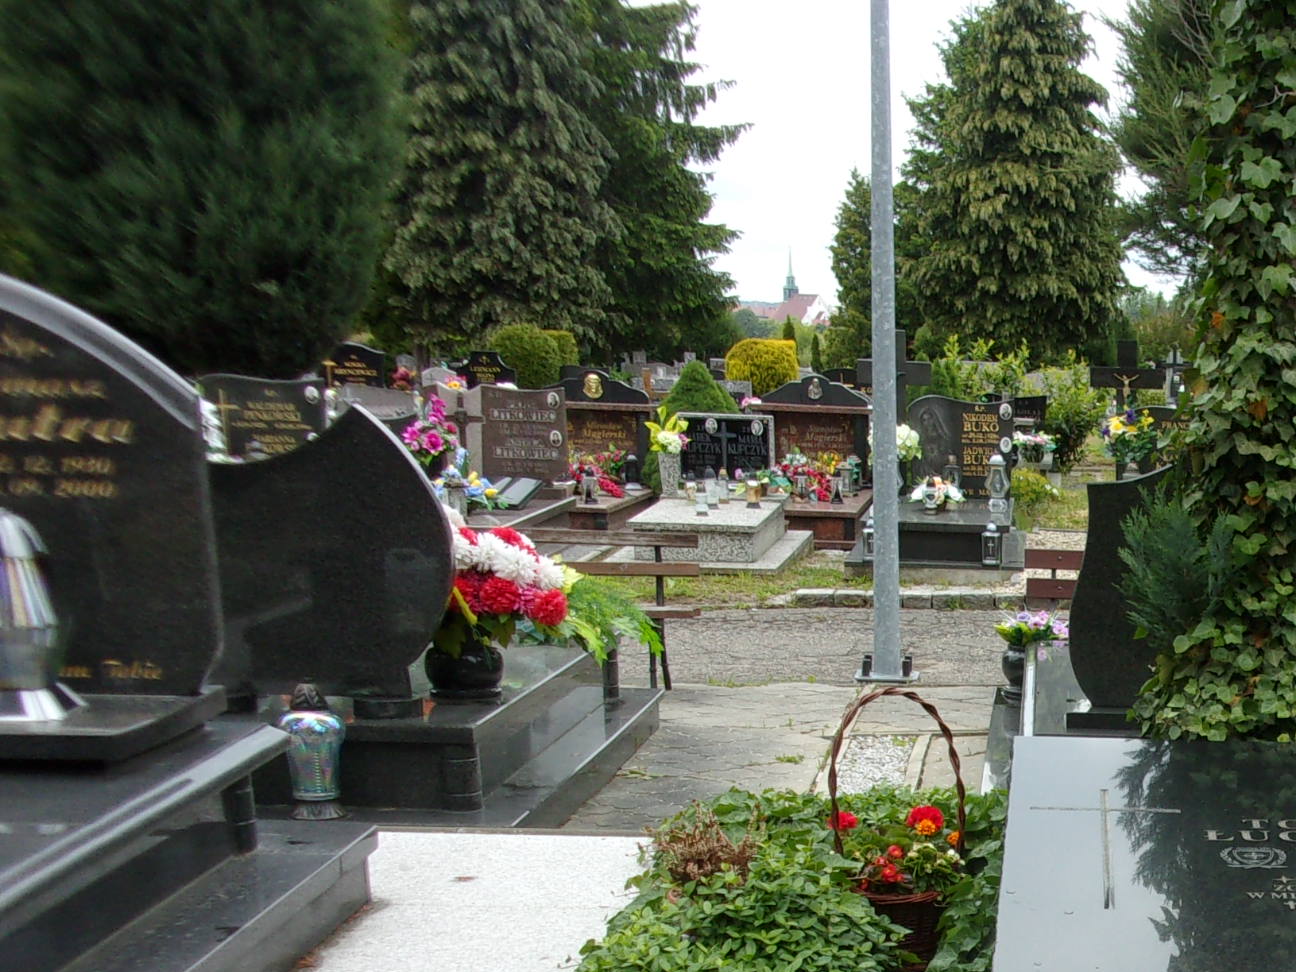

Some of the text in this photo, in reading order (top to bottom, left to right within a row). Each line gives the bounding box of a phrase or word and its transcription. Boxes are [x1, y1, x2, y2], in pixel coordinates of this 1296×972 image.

[963, 422, 1000, 432] BUKO
[688, 442, 721, 454] UPCZYK
[963, 455, 990, 465] BUK
[1246, 891, 1265, 899] W
